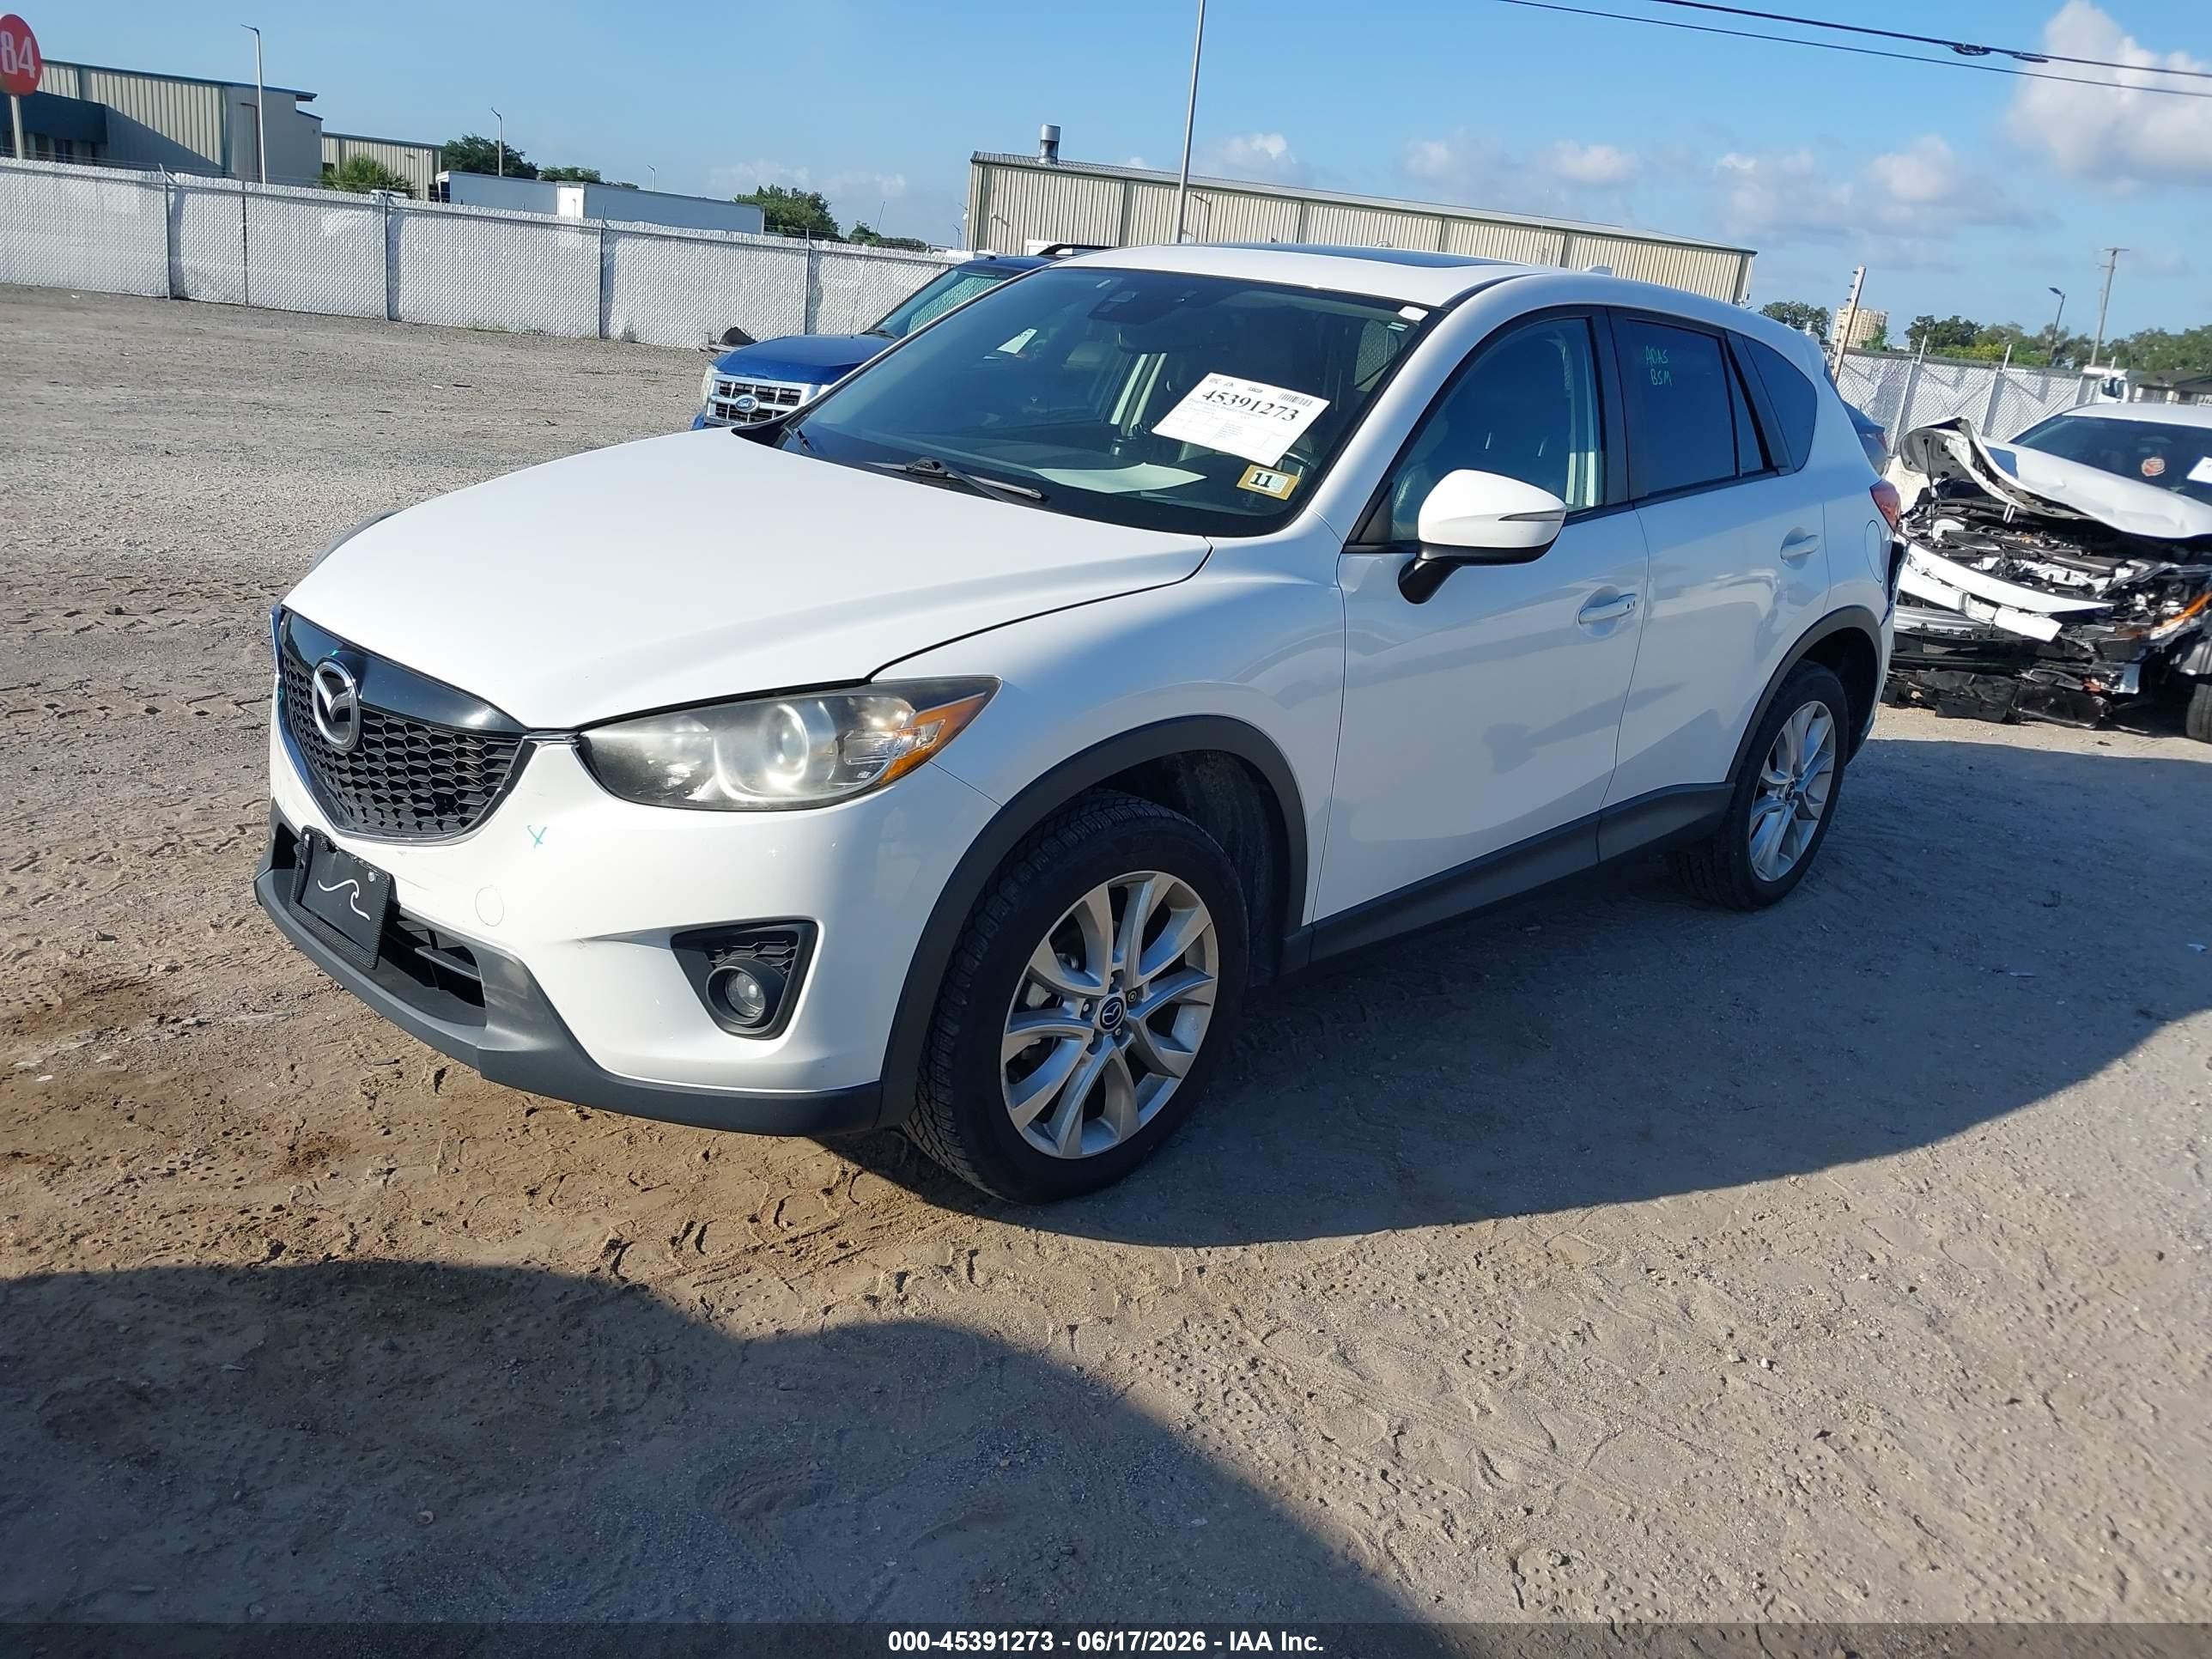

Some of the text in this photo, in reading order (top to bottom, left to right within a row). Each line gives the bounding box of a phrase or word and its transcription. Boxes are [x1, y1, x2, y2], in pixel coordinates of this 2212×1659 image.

[1, 30, 36, 79] 84
[1200, 389, 1300, 422] 45391273
[1249, 471, 1273, 489] 11
